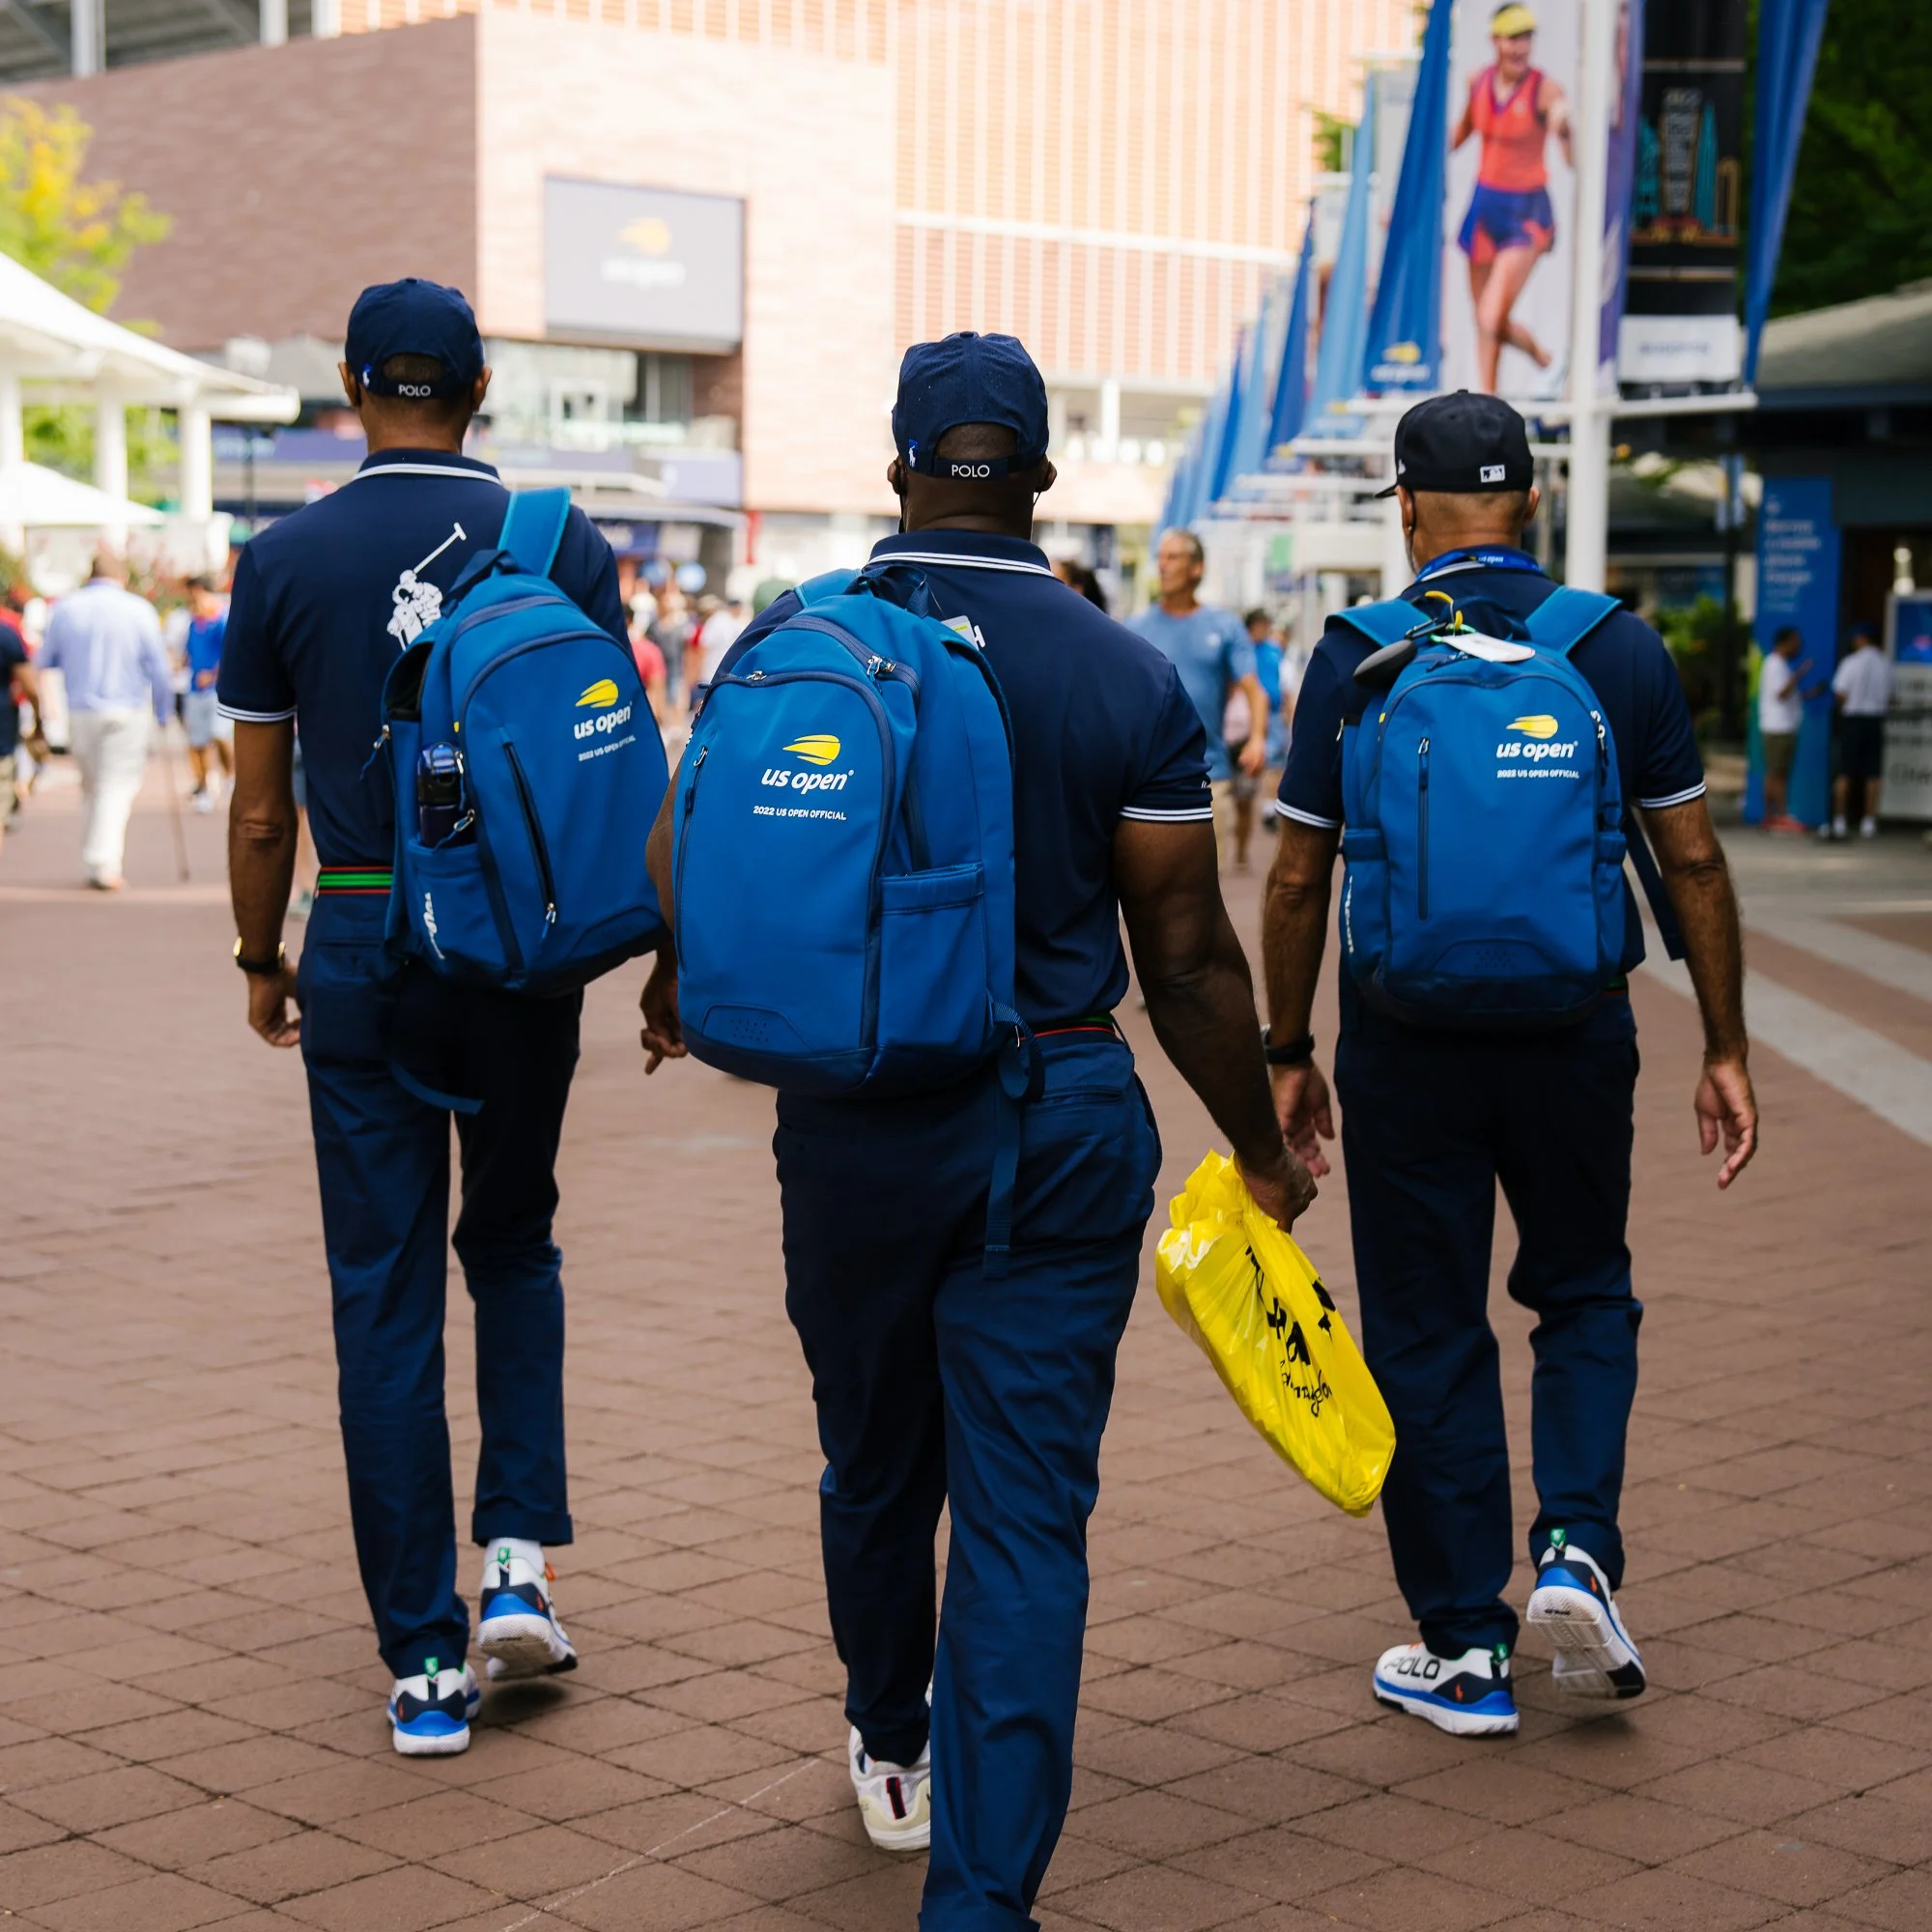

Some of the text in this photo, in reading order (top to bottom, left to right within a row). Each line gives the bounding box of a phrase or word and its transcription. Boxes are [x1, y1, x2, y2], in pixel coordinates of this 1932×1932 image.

[398, 384, 432, 396] POLO
[951, 464, 990, 477] POLO
[574, 705, 631, 740] us open
[1495, 742, 1575, 762] us open
[760, 768, 848, 795] us open
[1517, 769, 1528, 778] US
[1527, 769, 1548, 779] OPEN
[1548, 769, 1580, 780] OFFICIAL
[753, 805, 847, 821] 2022 US OPEN OFFICIAL
